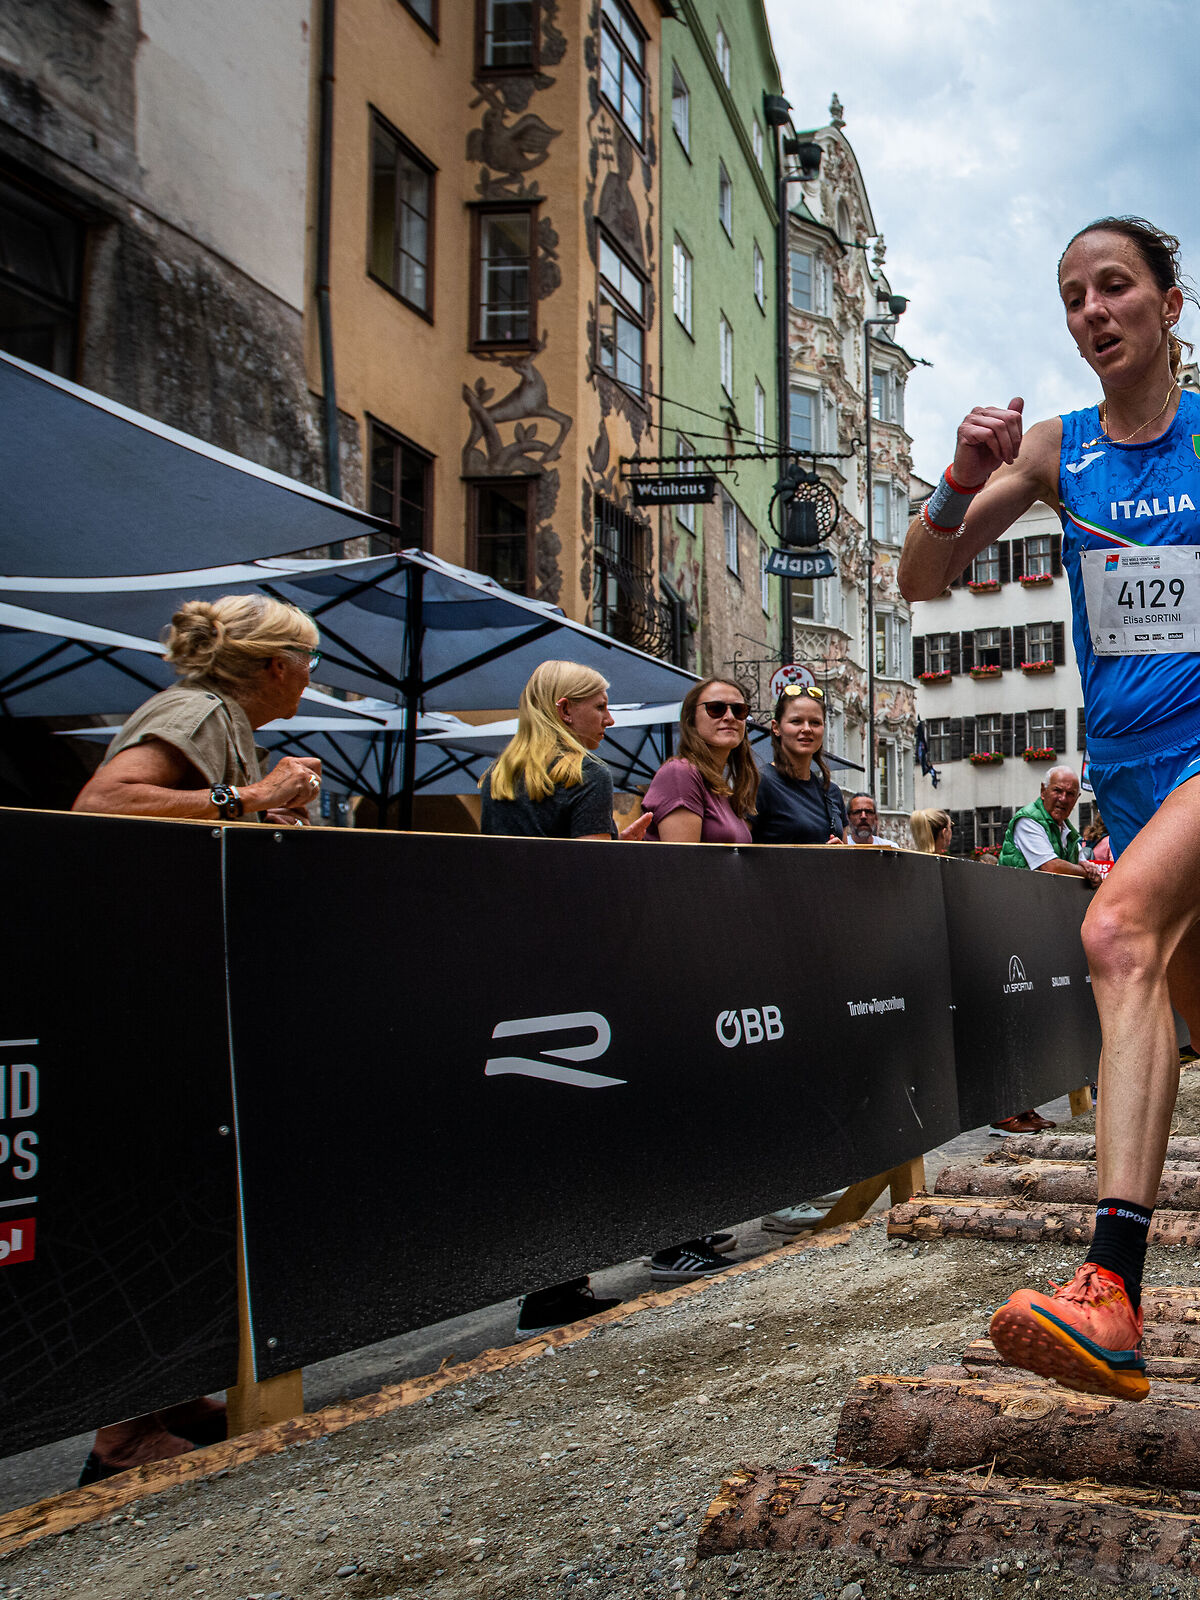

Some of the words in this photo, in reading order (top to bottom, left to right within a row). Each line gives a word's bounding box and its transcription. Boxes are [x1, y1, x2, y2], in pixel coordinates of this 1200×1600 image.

[637, 481, 706, 496] Weinhaus
[1110, 493, 1196, 520] ITALIA
[773, 553, 826, 574] Happ
[1117, 579, 1185, 609] 4129
[1123, 615, 1144, 625] Elisa
[1145, 613, 1181, 623] SORTINI
[847, 1001, 869, 1017] Tiroler
[715, 1005, 785, 1048] ÖBB
